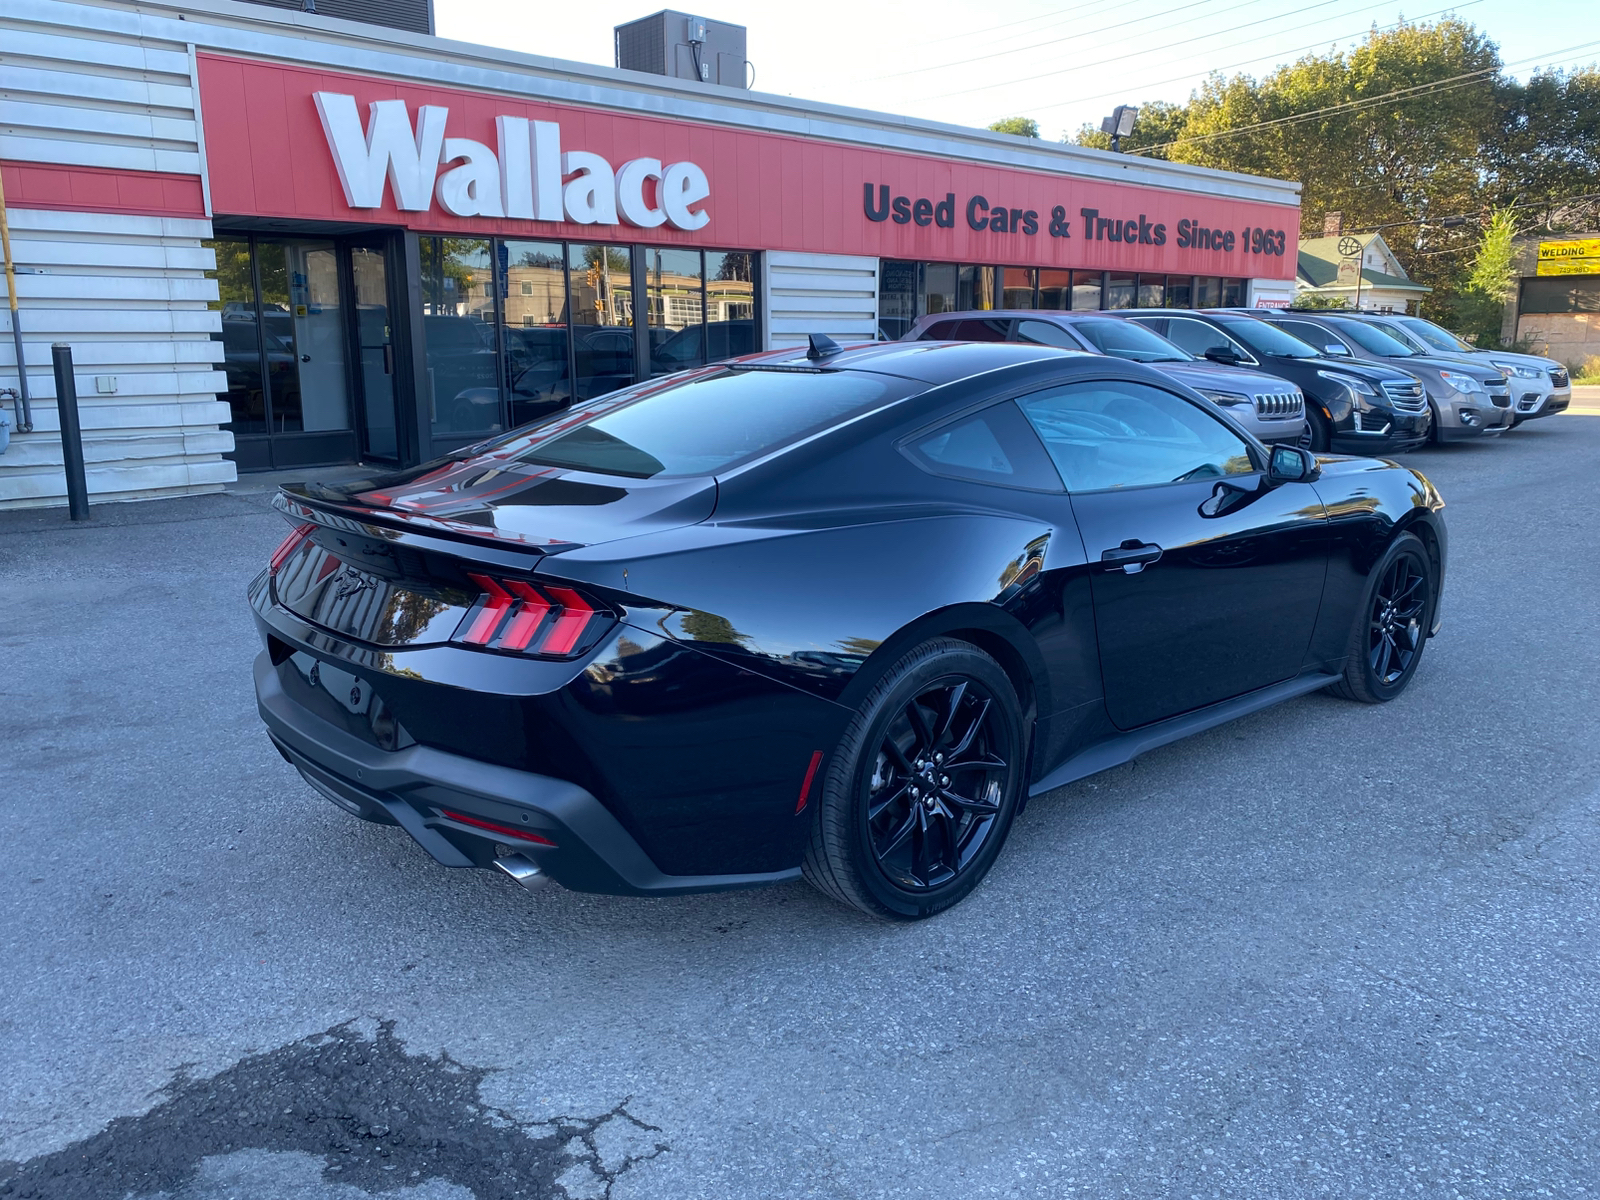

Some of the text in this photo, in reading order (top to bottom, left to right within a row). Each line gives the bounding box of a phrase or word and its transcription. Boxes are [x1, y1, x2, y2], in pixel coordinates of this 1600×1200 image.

[312, 91, 711, 231] Wallace
[863, 182, 1286, 257] Used Cars & Trucks Since 1963
[1541, 247, 1585, 257] WELDING
